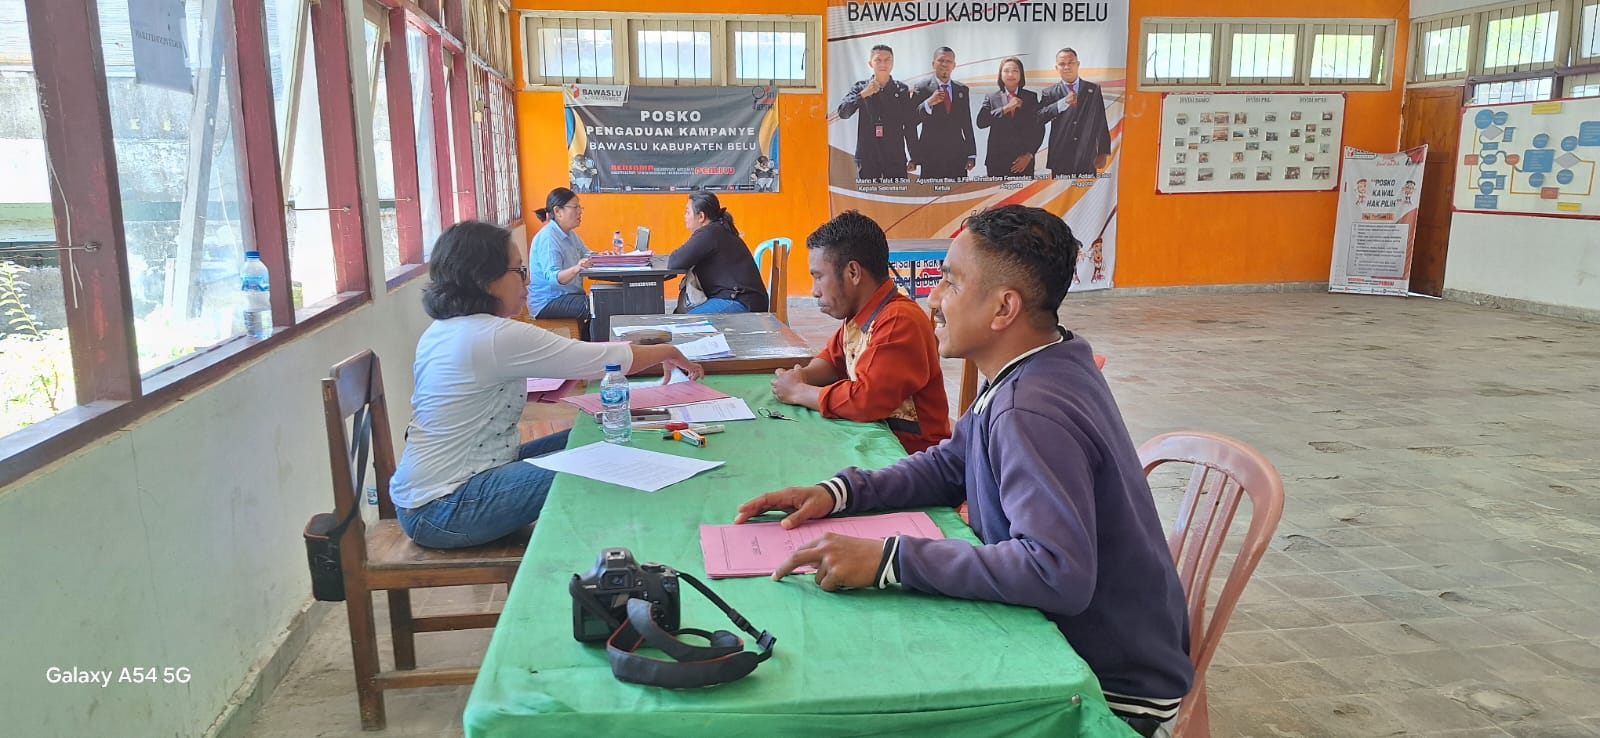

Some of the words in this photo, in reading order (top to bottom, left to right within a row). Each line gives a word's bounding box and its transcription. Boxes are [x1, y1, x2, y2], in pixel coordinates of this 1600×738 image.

[848, 2, 940, 22] BAWASLU
[946, 2, 1056, 22] KABUPATEN
[1062, 2, 1108, 22] BELU
[583, 89, 622, 97] BAWASLU
[640, 110, 701, 122] POSKO
[586, 126, 673, 137] PENGADUAN
[679, 126, 755, 137] KAMPANYE
[589, 142, 648, 151] BAWASLU
[652, 142, 723, 151] KABUPATEN
[727, 142, 756, 151] BELU
[1371, 189, 1395, 197] KAWAL
[1366, 200, 1379, 208] HAK
